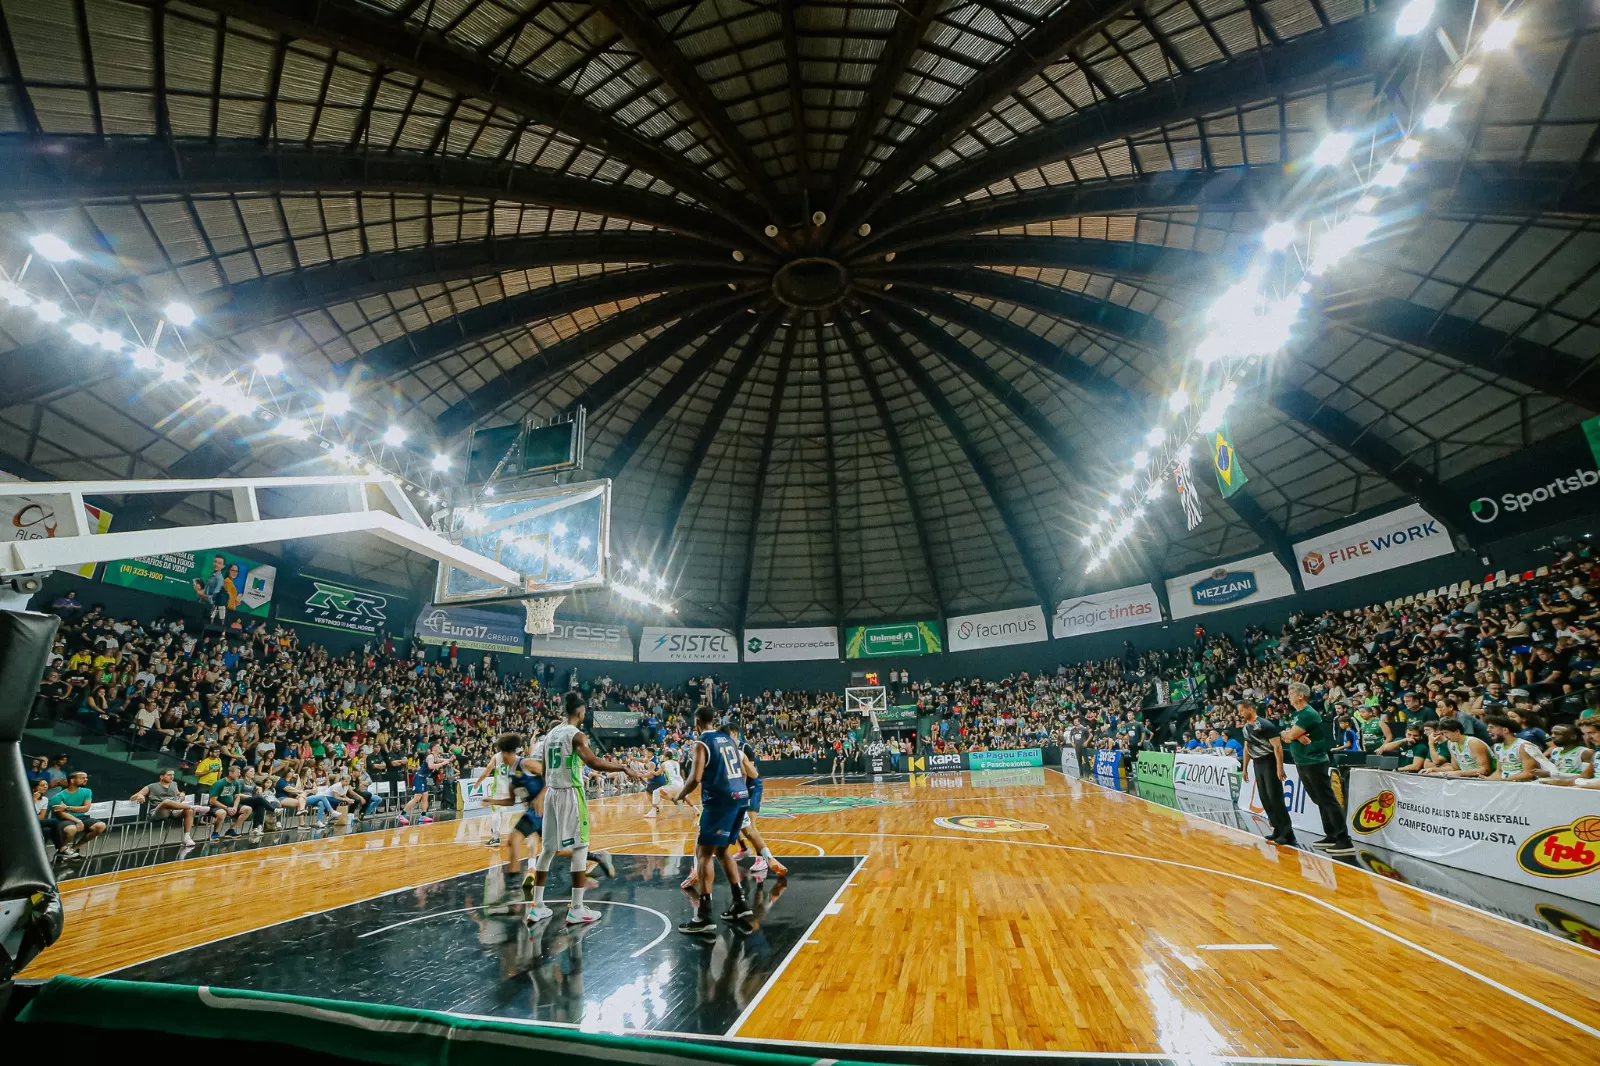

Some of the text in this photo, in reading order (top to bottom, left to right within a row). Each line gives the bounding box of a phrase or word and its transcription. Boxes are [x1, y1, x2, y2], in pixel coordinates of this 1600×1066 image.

[1501, 468, 1600, 513] Sportsb
[1328, 520, 1440, 564] FIREWORK
[1196, 579, 1252, 600] MEZZANI
[441, 621, 488, 639] Euro17
[870, 632, 902, 642] Unimed
[976, 619, 1037, 638] facimus
[669, 634, 728, 652] SISTEL
[548, 747, 561, 769] 15
[720, 745, 742, 779] 12
[986, 751, 1015, 761] Pagou
[1137, 761, 1171, 779] PENALTY
[1186, 763, 1227, 787] ZOPONE
[1363, 804, 1386, 824] fpb
[1461, 811, 1471, 820] DE
[1473, 813, 1530, 826] BASKETBALL
[1398, 817, 1517, 846] CAMPEONATO PAULISTA
[1543, 835, 1595, 865] fpb
